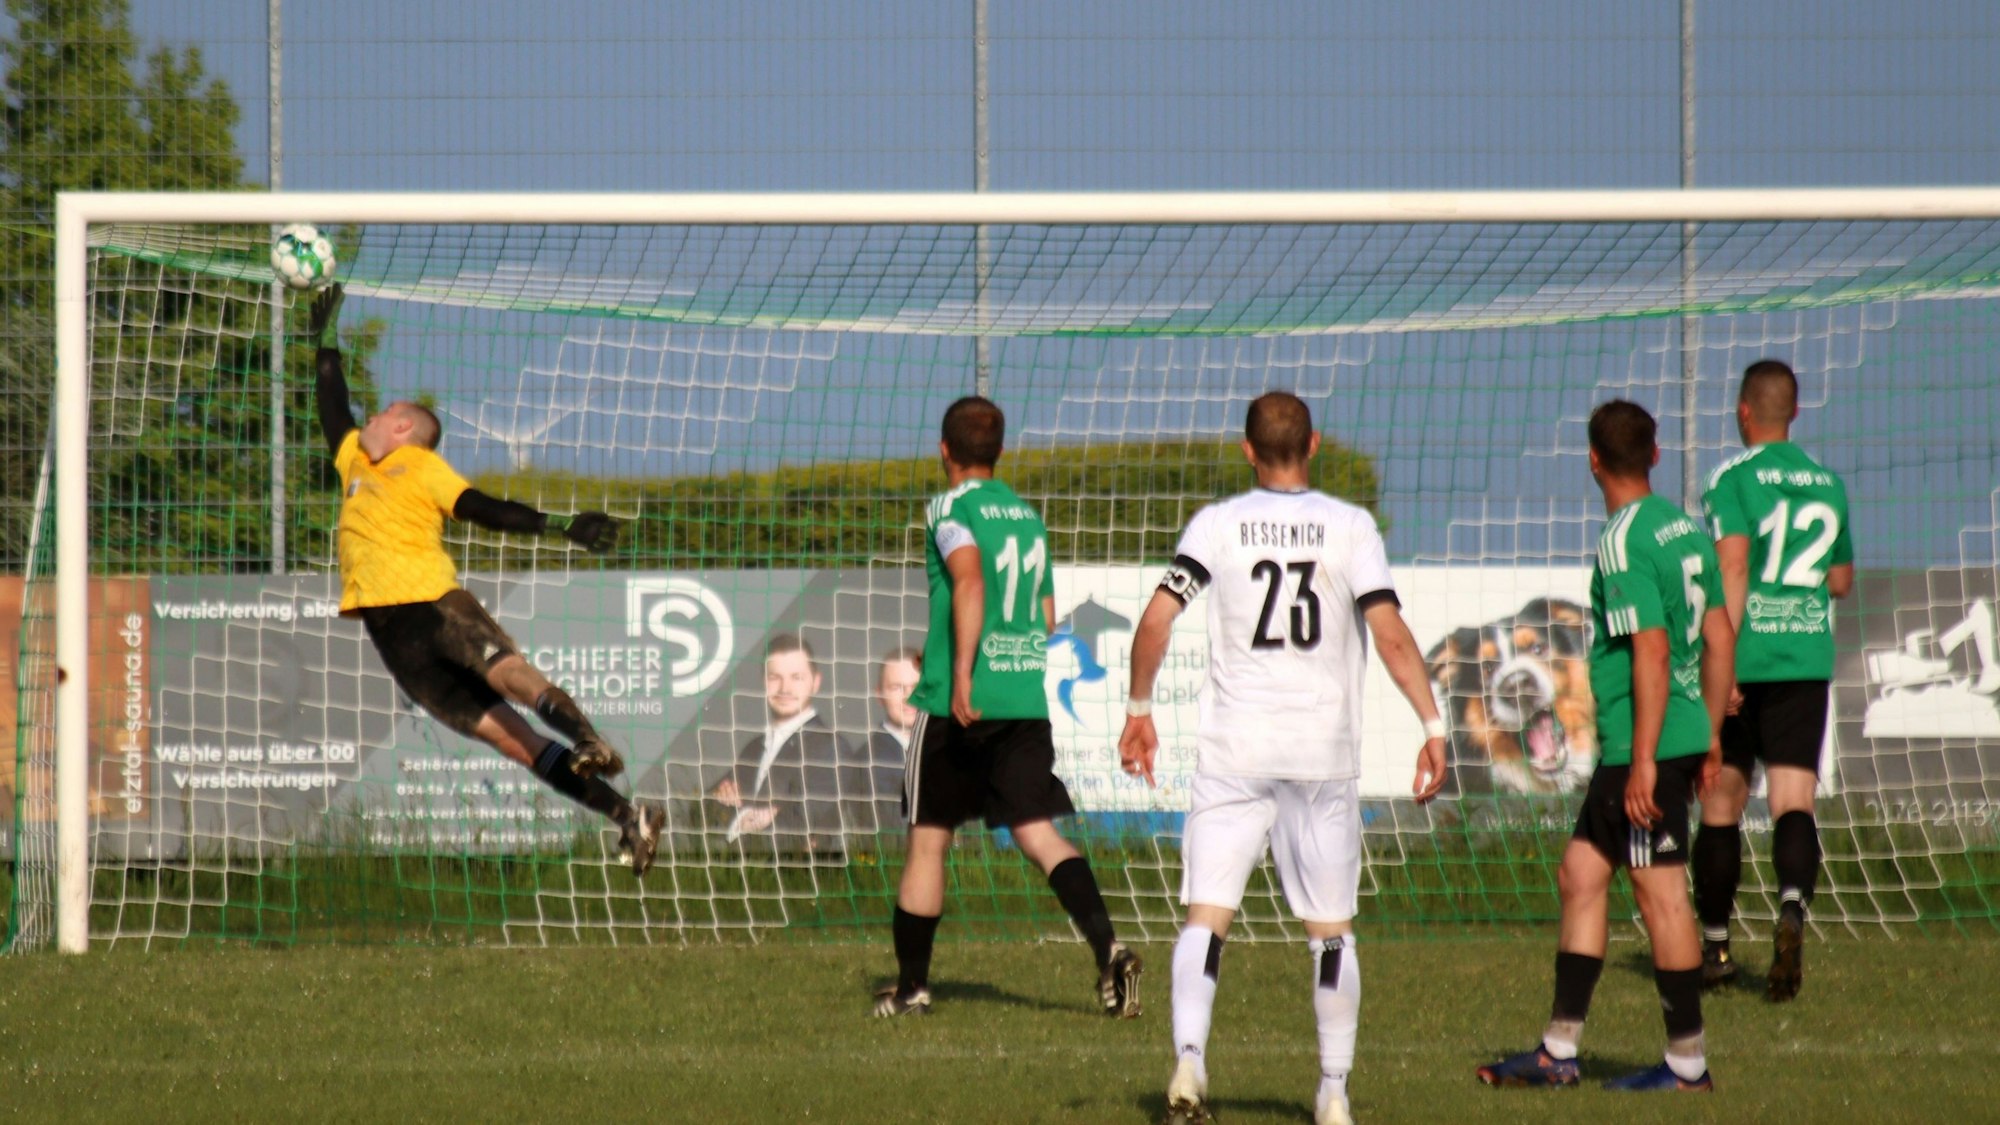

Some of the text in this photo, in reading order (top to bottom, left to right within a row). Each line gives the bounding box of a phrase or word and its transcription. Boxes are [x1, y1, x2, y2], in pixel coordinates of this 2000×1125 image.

[1240, 521, 1325, 548] BESSENICH
[1758, 499, 1840, 588] 12
[995, 534, 1046, 622] 11
[153, 601, 297, 622] Versicherung,
[1250, 559, 1322, 652] 23
[1681, 555, 1706, 647] 5
[547, 673, 660, 698] GHOFF
[580, 700, 663, 716] NZIERUNG
[156, 743, 355, 762] Wähle aus über 100
[173, 770, 337, 791] Versicherungen
